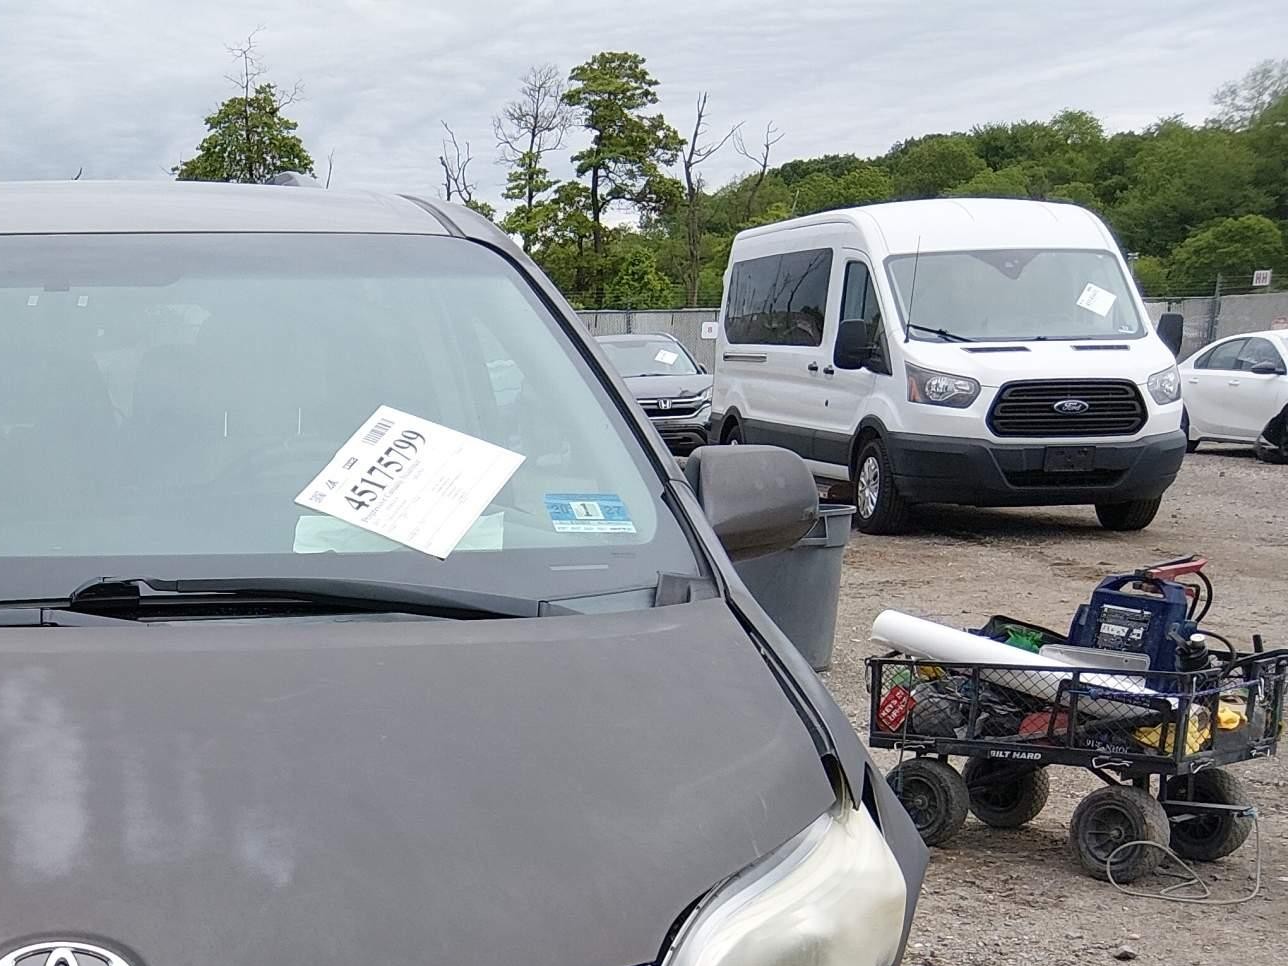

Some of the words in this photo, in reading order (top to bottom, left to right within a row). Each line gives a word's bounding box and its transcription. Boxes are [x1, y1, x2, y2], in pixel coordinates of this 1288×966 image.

[1062, 402, 1081, 412] Ford
[343, 429, 427, 511] 45175799
[580, 503, 592, 517] 1
[1011, 751, 1042, 760] HARD
